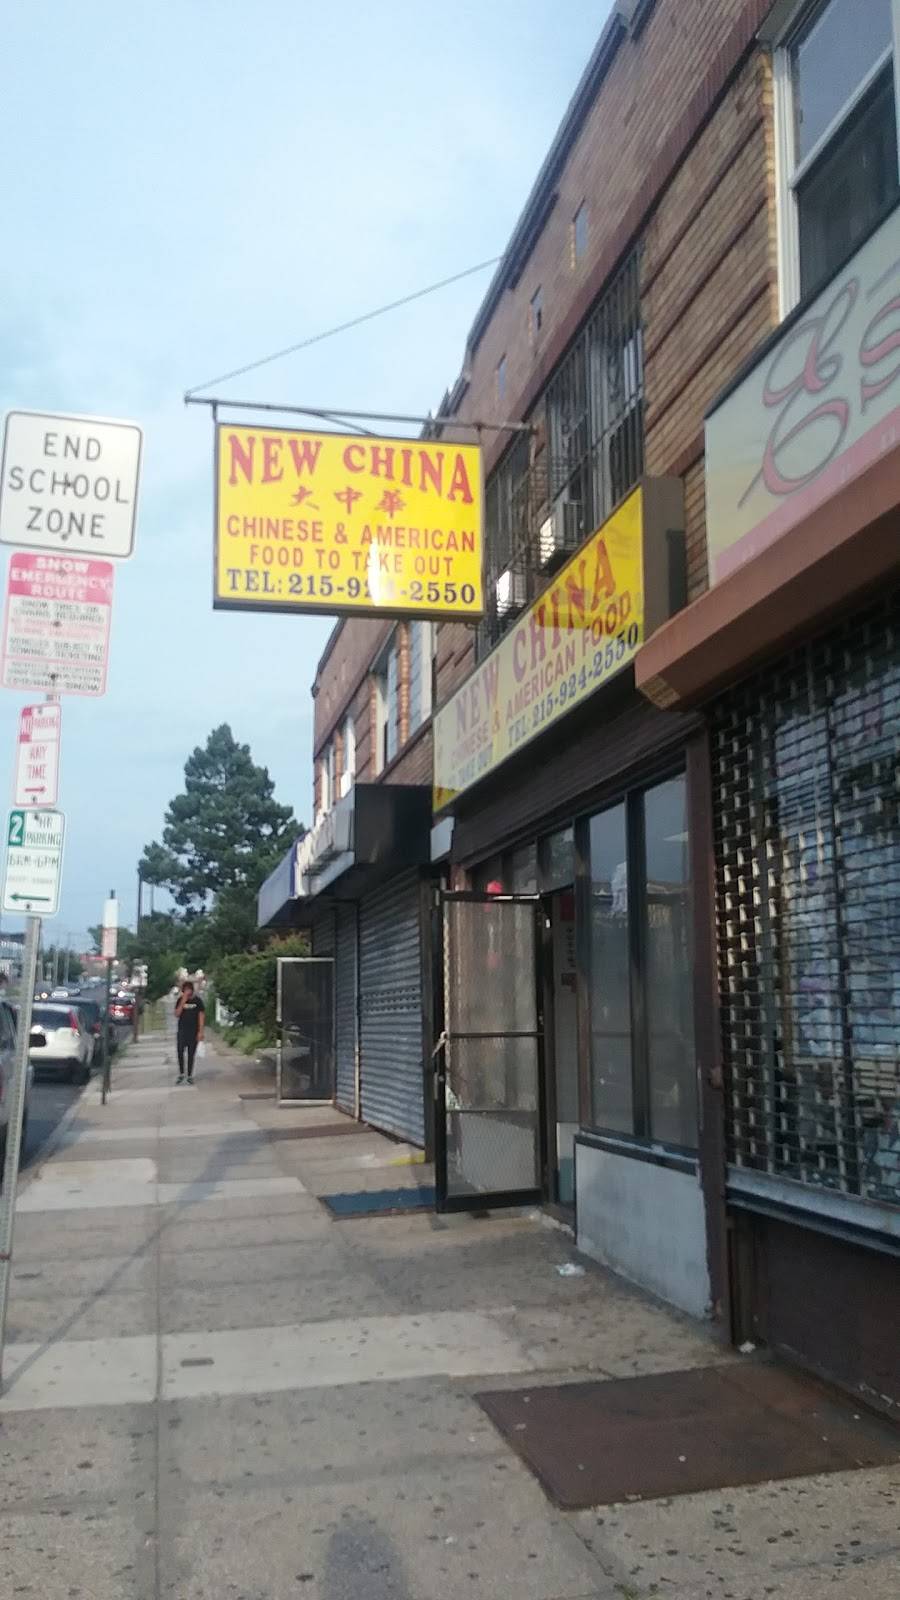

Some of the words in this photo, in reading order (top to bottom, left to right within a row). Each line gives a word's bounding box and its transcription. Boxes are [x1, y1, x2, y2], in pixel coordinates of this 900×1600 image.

[44, 432, 101, 461] END
[8, 466, 129, 504] SCHOOL
[228, 434, 323, 486] NEW
[343, 444, 474, 504] CHINA
[26, 506, 105, 539] ZONE
[227, 514, 323, 543] CHINESE
[334, 522, 349, 545] &
[360, 524, 475, 553] AMERICAN
[250, 544, 303, 567] FOOD
[316, 549, 341, 570] TO
[352, 551, 403, 575] TAKE
[414, 555, 454, 577] OUT
[454, 652, 500, 742] NEW
[513, 537, 616, 684] CHINA
[505, 638, 577, 722] AMERICAN
[581, 590, 632, 655] FOOD
[532, 621, 639, 729] 215-924-2550
[30, 744, 47, 761] ANY
[27, 763, 46, 779] TIME
[10, 814, 23, 844] 2
[39, 816, 53, 829] HR
[27, 831, 61, 846] PARKING
